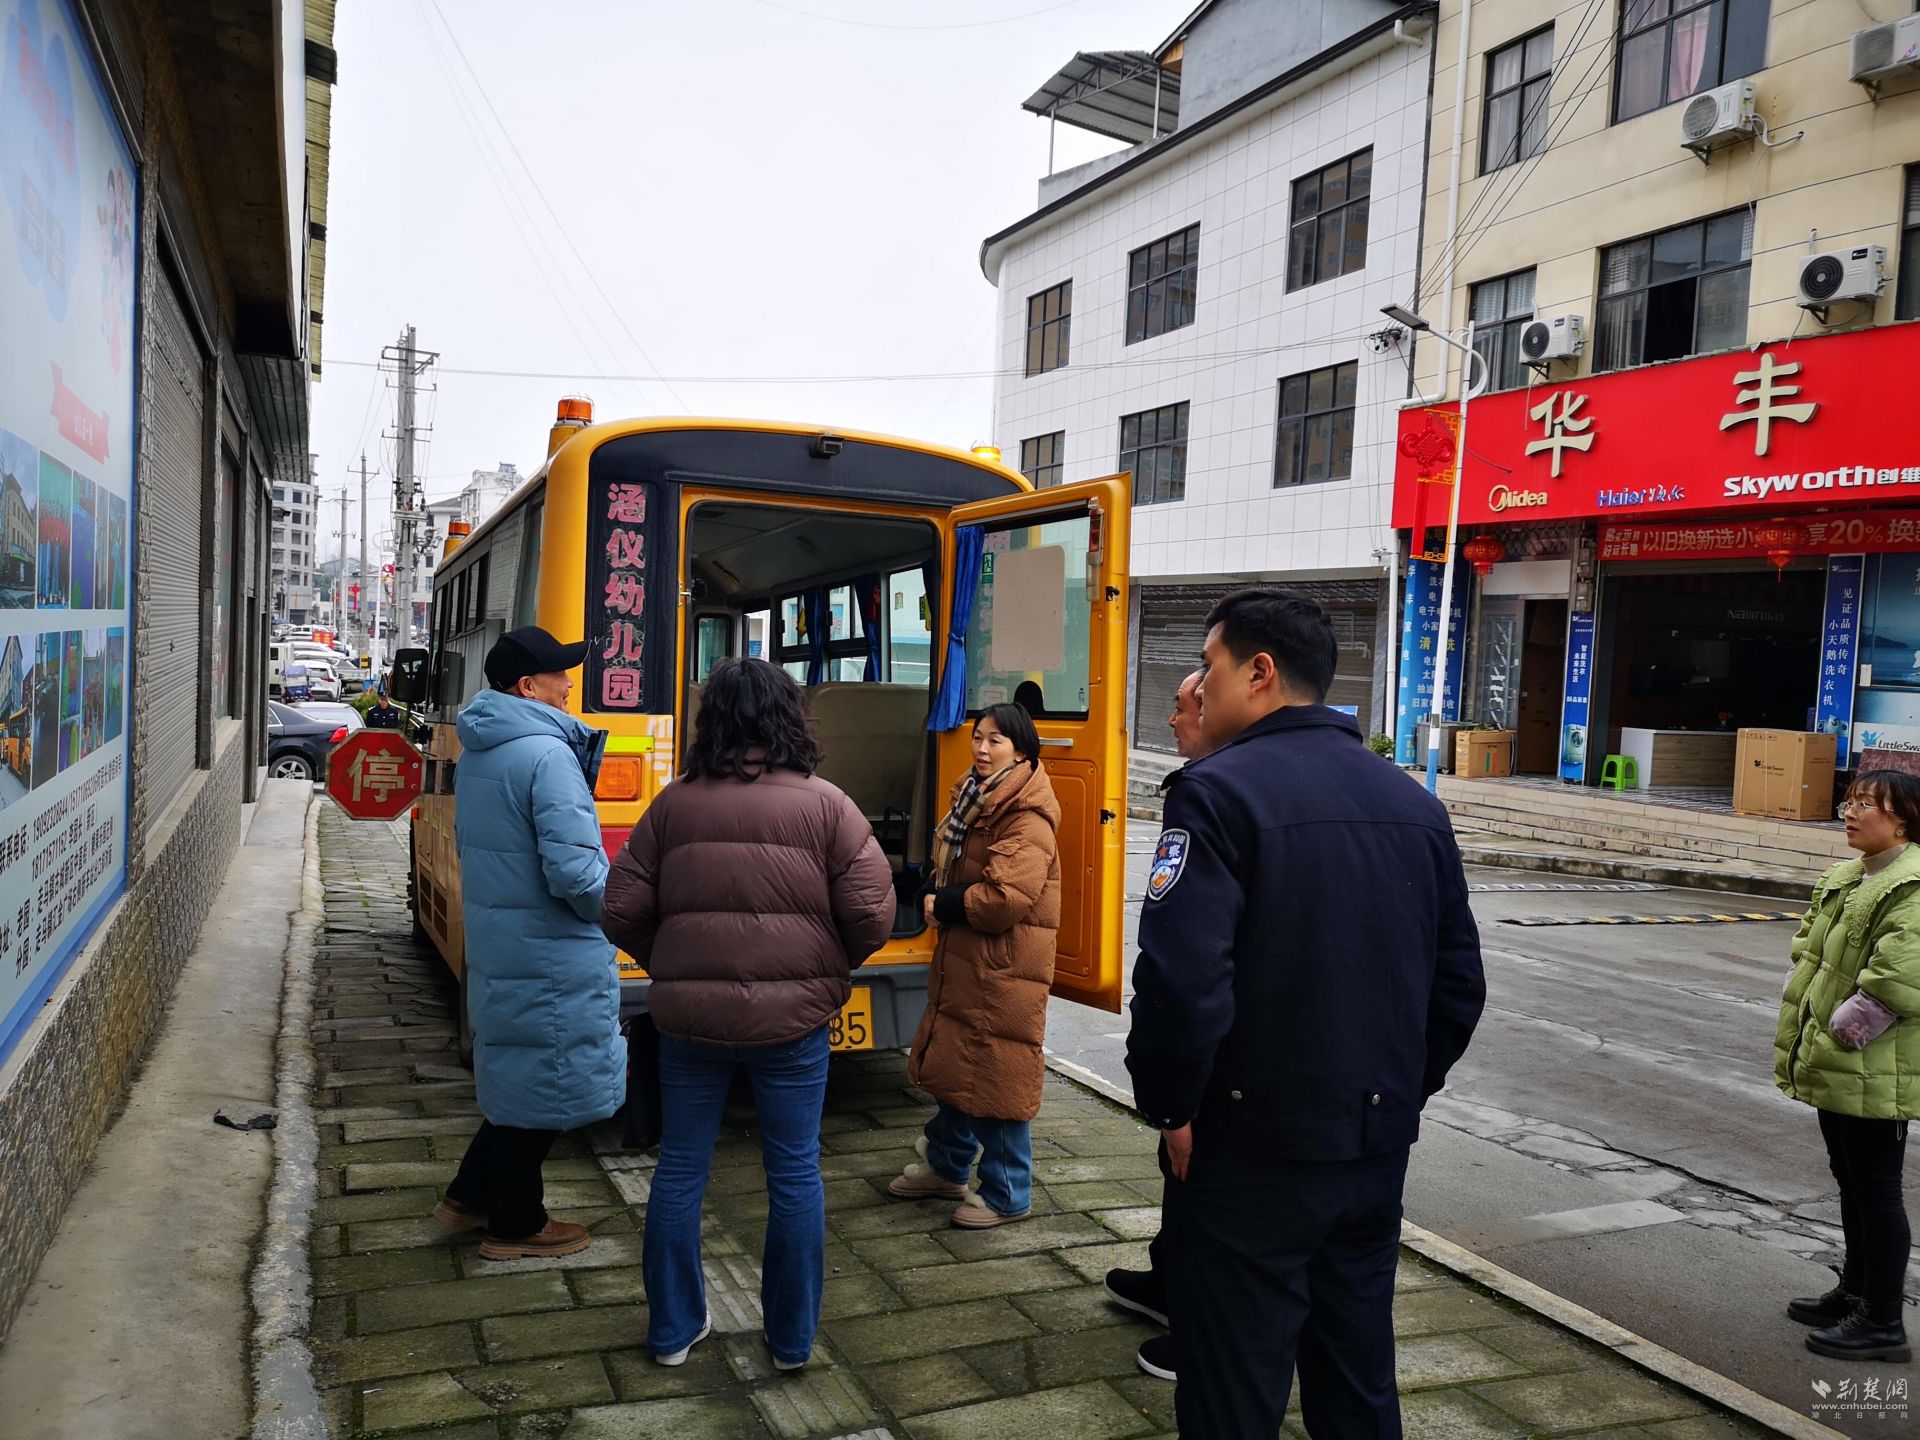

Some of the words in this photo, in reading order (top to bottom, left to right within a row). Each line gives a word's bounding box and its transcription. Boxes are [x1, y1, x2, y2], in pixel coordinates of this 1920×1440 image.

[1489, 485, 1548, 512] Midea
[1598, 488, 1645, 507] Haier
[602, 482, 646, 708] 涵仪幼儿园
[1422, 621, 1457, 633] 小家等
[1837, 588, 1853, 676] 见证品质传奇
[1823, 619, 1839, 706] 小天鹅洗衣机
[1417, 684, 1451, 695] 抽油机
[1412, 698, 1455, 709] 旧家回收
[347, 747, 406, 803] 停
